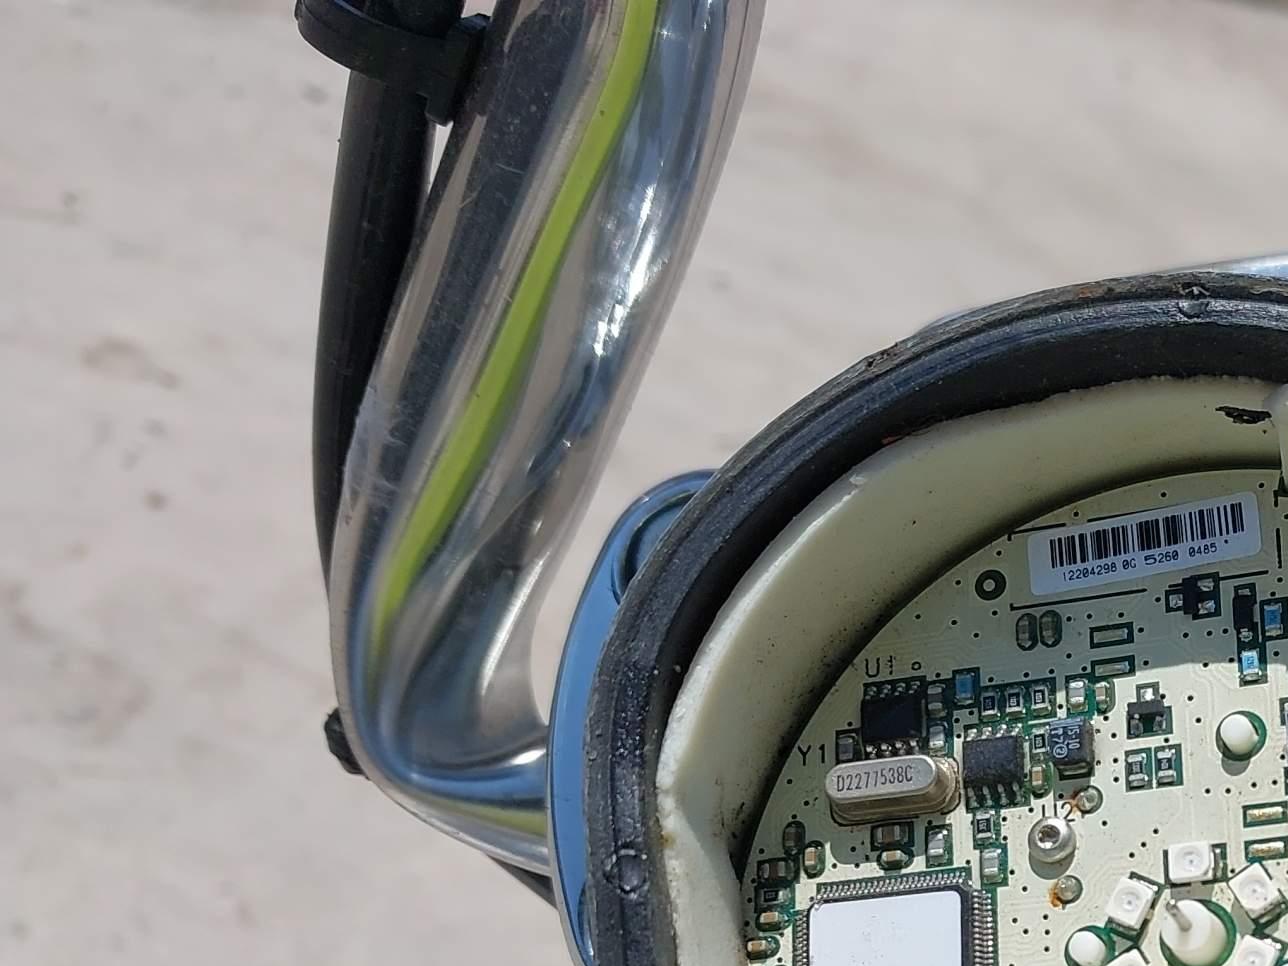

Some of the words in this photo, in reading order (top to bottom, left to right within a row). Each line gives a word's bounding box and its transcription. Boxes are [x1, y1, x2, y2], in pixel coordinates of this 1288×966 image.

[1063, 563, 1118, 582] 12204298
[1144, 551, 1180, 566] 5260
[1188, 543, 1218, 558] 0485
[796, 743, 827, 767] Y1
[836, 764, 914, 793] D2277538C
